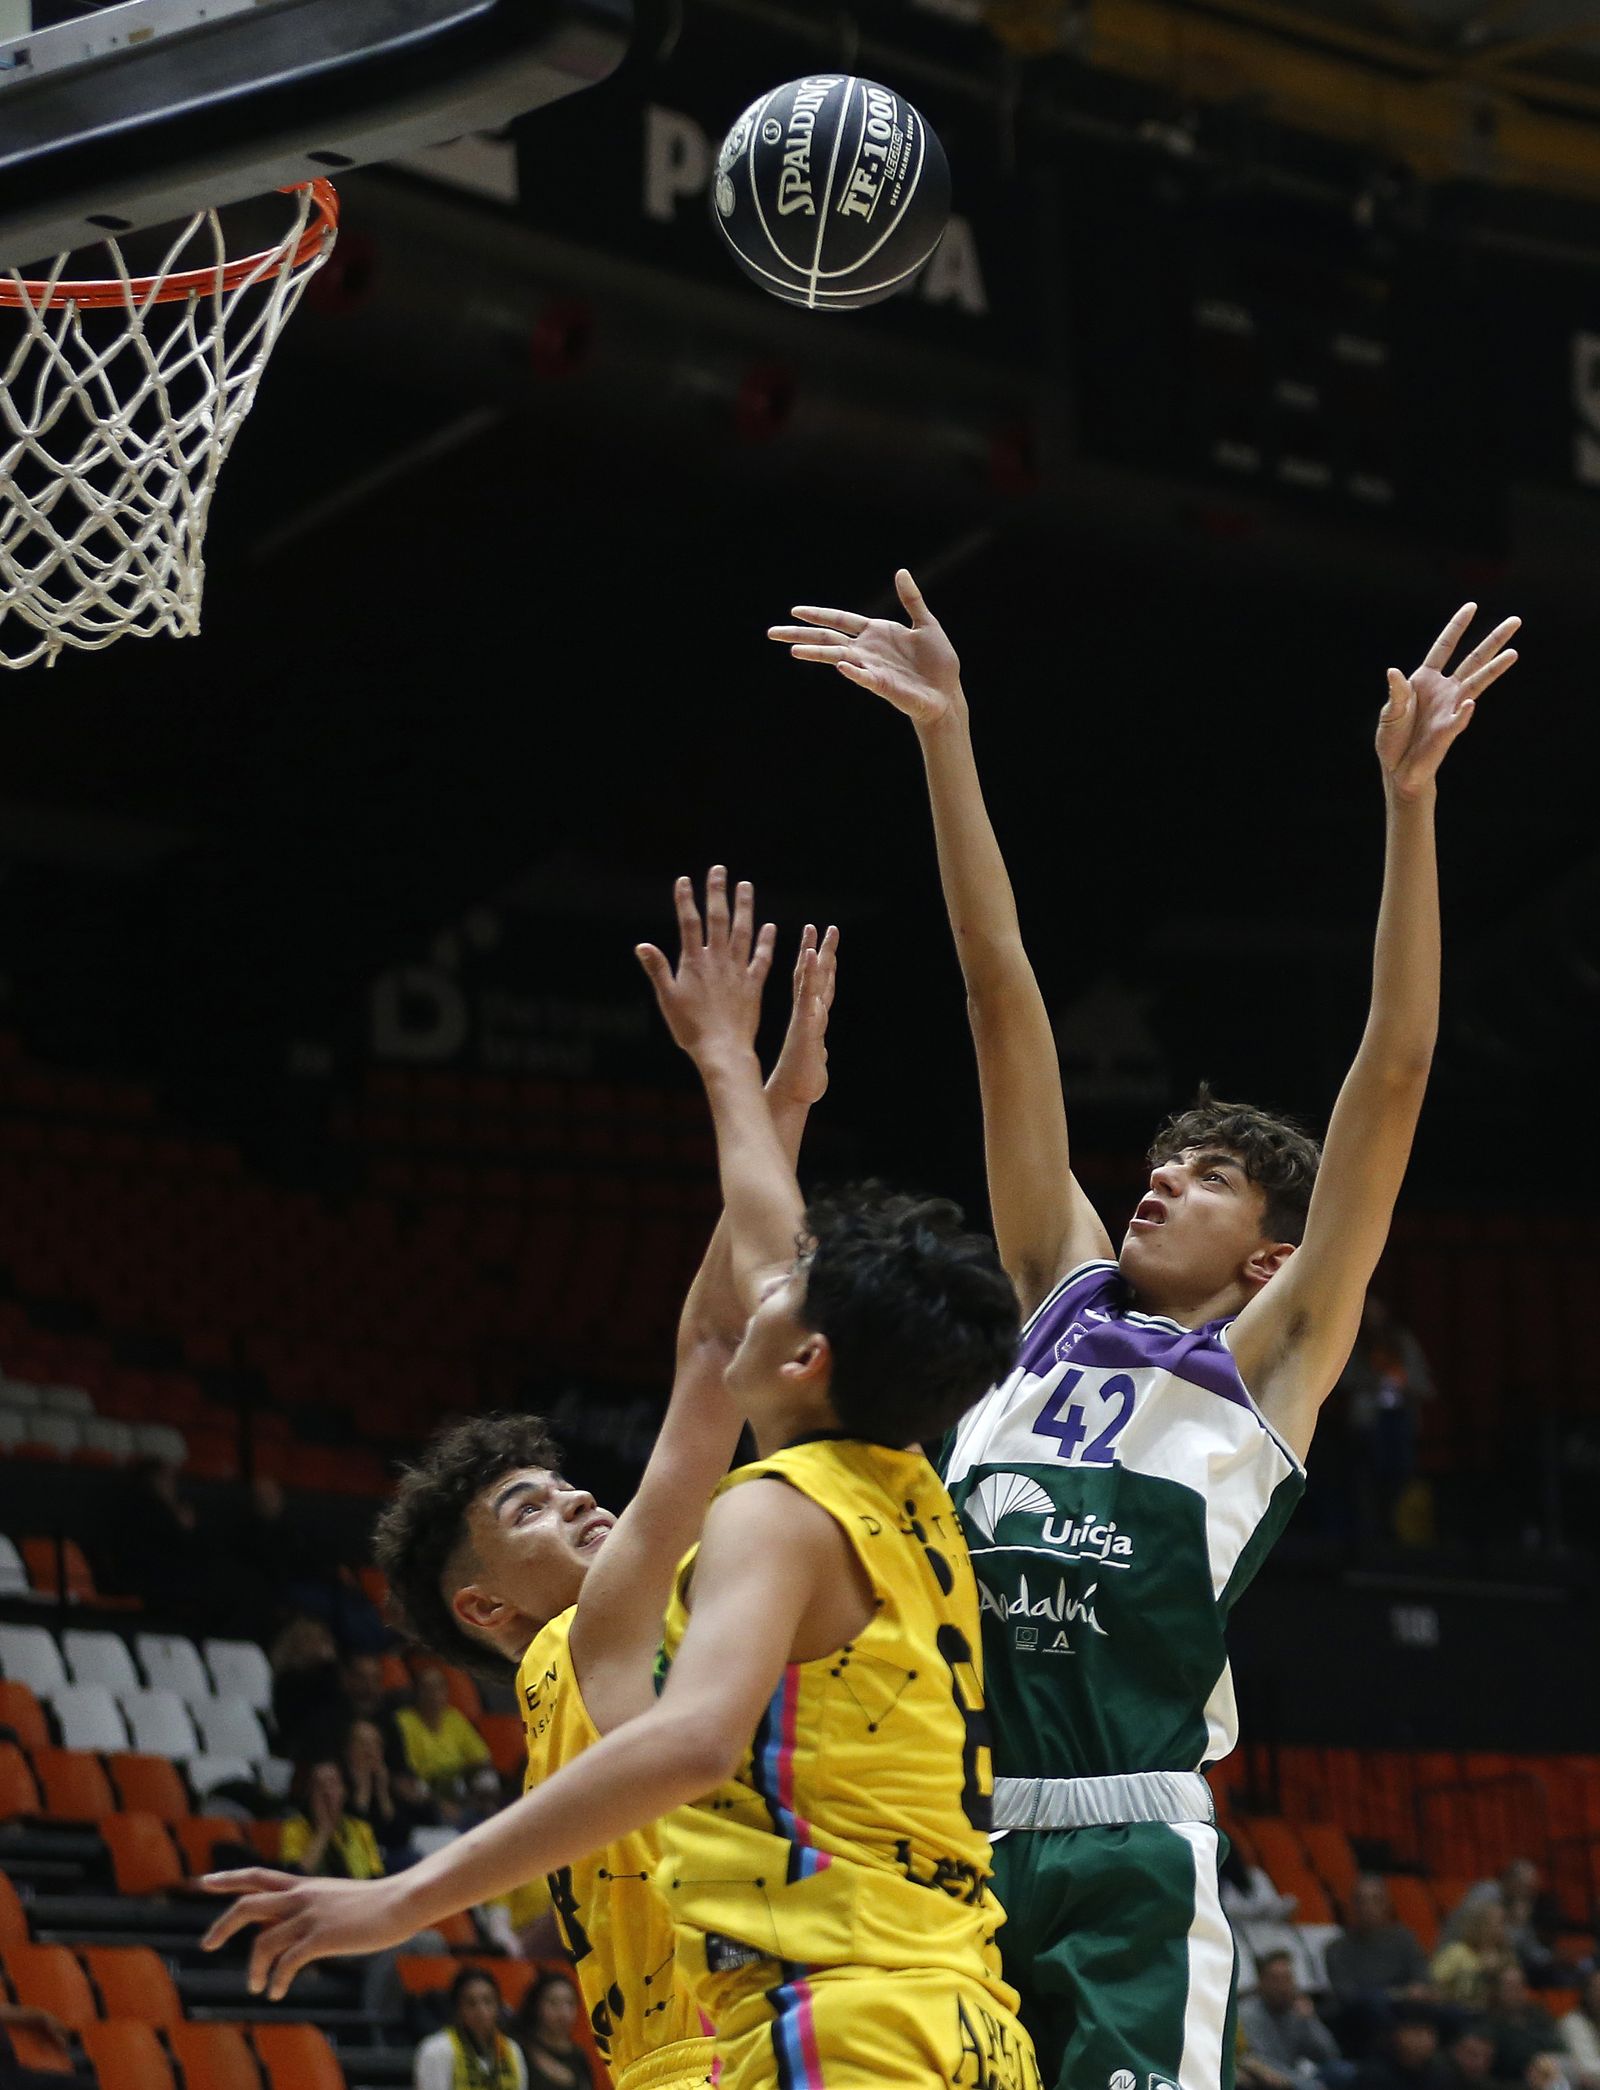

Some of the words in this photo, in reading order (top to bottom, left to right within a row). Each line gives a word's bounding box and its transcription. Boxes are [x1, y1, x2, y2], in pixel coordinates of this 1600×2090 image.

[778, 78, 839, 216] SPALDING
[841, 88, 894, 217] TF-1000
[1032, 1368, 1136, 1463] 42
[1042, 1514, 1133, 1560] Uicja
